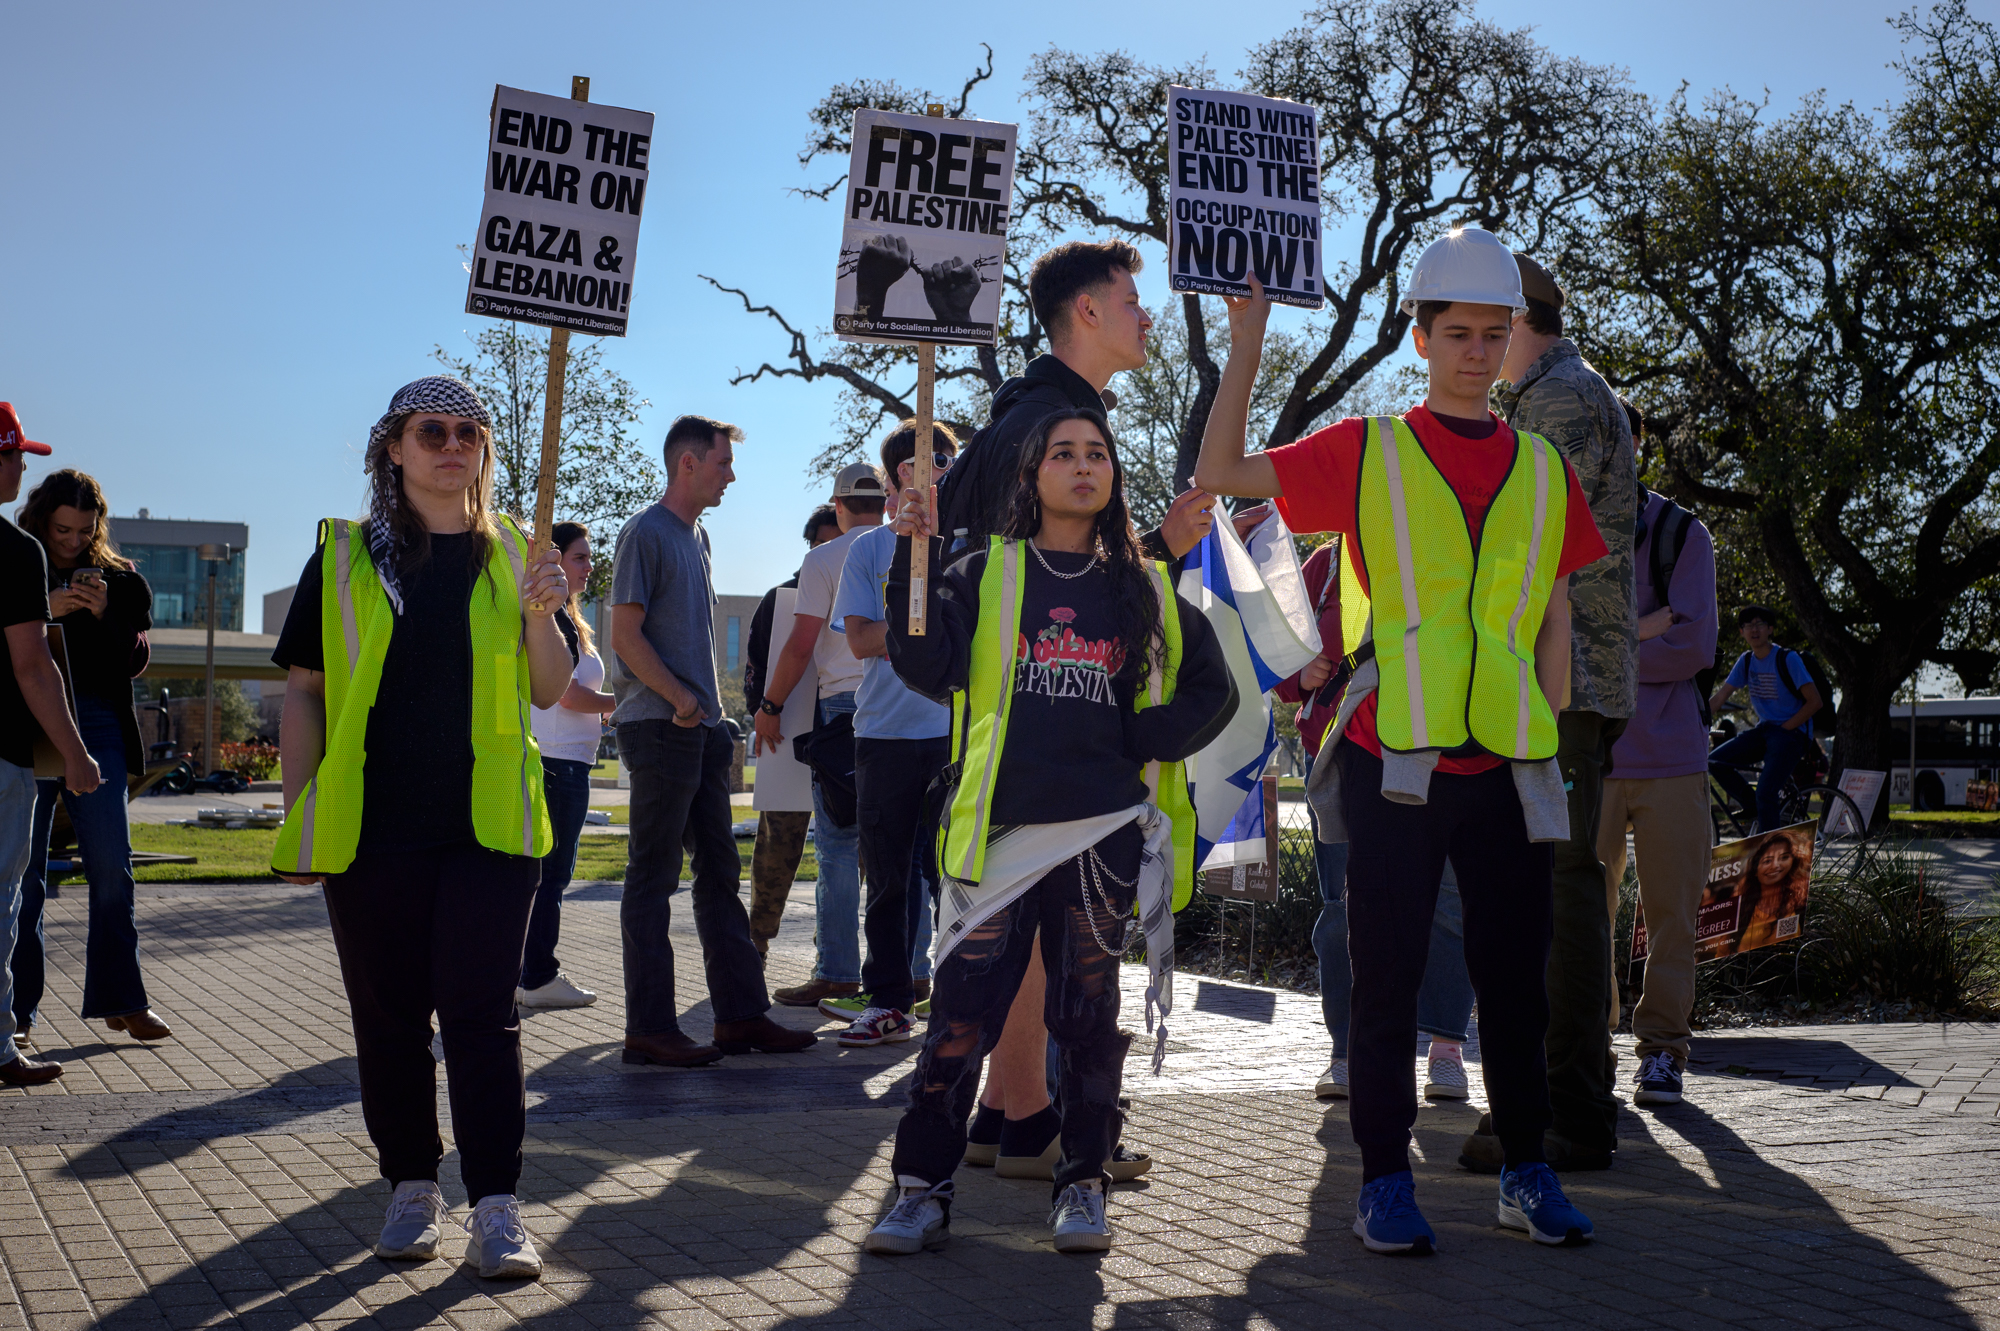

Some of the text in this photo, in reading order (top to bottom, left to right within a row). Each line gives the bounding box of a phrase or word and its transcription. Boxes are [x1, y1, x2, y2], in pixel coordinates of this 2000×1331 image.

[1175, 97, 1314, 138] STAND WITH
[497, 108, 650, 171] END THE
[1178, 123, 1317, 165] PALESTINE!
[492, 151, 644, 216] WAR ON
[864, 124, 1006, 201] FREE
[1178, 151, 1318, 204] END THE
[851, 187, 1009, 236] PALESTINE
[1175, 197, 1318, 240] OCCUPATION
[484, 215, 623, 274] GAZA &
[1178, 222, 1316, 292] NOW!
[474, 257, 631, 313] LEBANON!
[1190, 281, 1321, 307] Party for Sociali and Liberation
[490, 302, 624, 333] Party for Socialism and Liberation
[852, 319, 992, 337] Party for Socialism and Liberation
[1249, 879, 1268, 893] Globally
[1695, 919, 1730, 938] EGREE?
[1698, 901, 1733, 915] MAJORS:
[1704, 942, 1719, 952] you
[1720, 938, 1736, 946] can.
